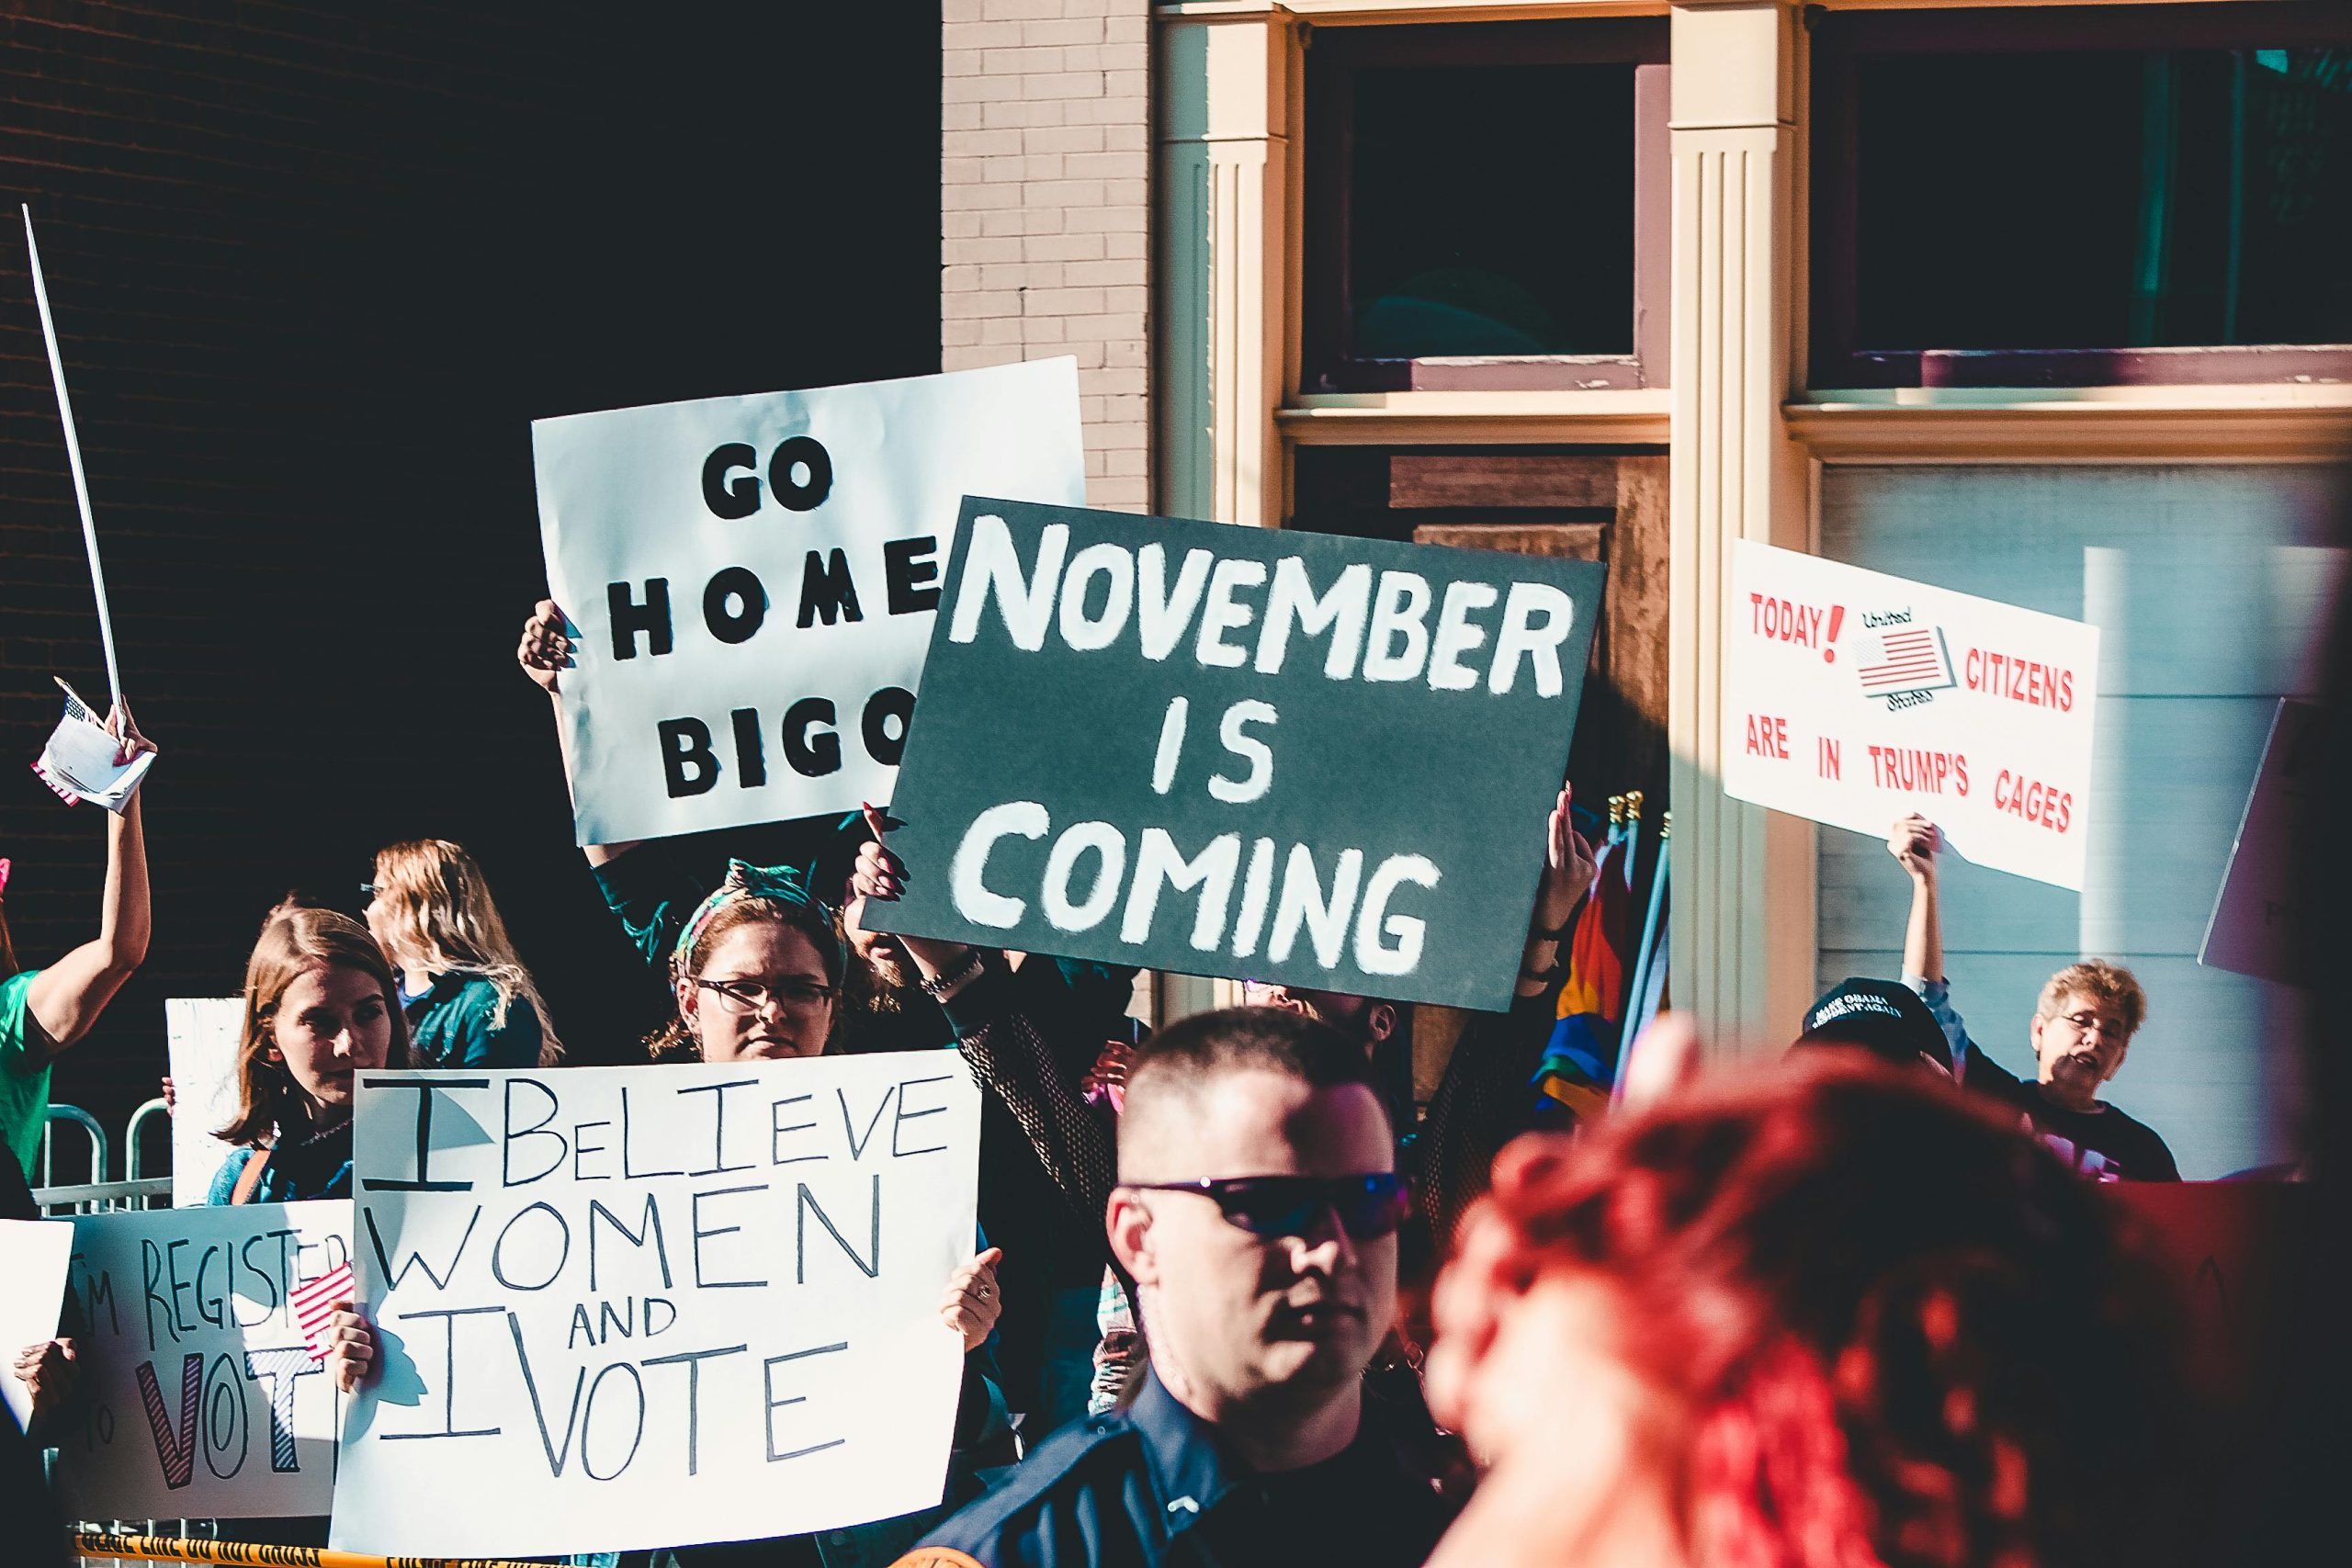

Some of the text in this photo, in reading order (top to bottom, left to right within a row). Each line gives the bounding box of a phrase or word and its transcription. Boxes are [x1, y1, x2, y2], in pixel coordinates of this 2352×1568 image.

[701, 435, 832, 519] GO
[607, 536, 943, 661] HOME
[948, 514, 1576, 698] NOVEMBER
[1749, 592, 2075, 713] TODAY! CITIZENS
[1150, 695, 1280, 804] IS
[1746, 714, 2074, 833] ARE IN TRUMP'S CAGES
[949, 800, 1444, 976] COMING
[363, 1075, 954, 1191] I BELIEVE
[363, 1175, 879, 1292] WOMEN
[568, 1296, 677, 1349] AND
[135, 1346, 339, 1490] VOT
[379, 1306, 848, 1481] I VOTE
